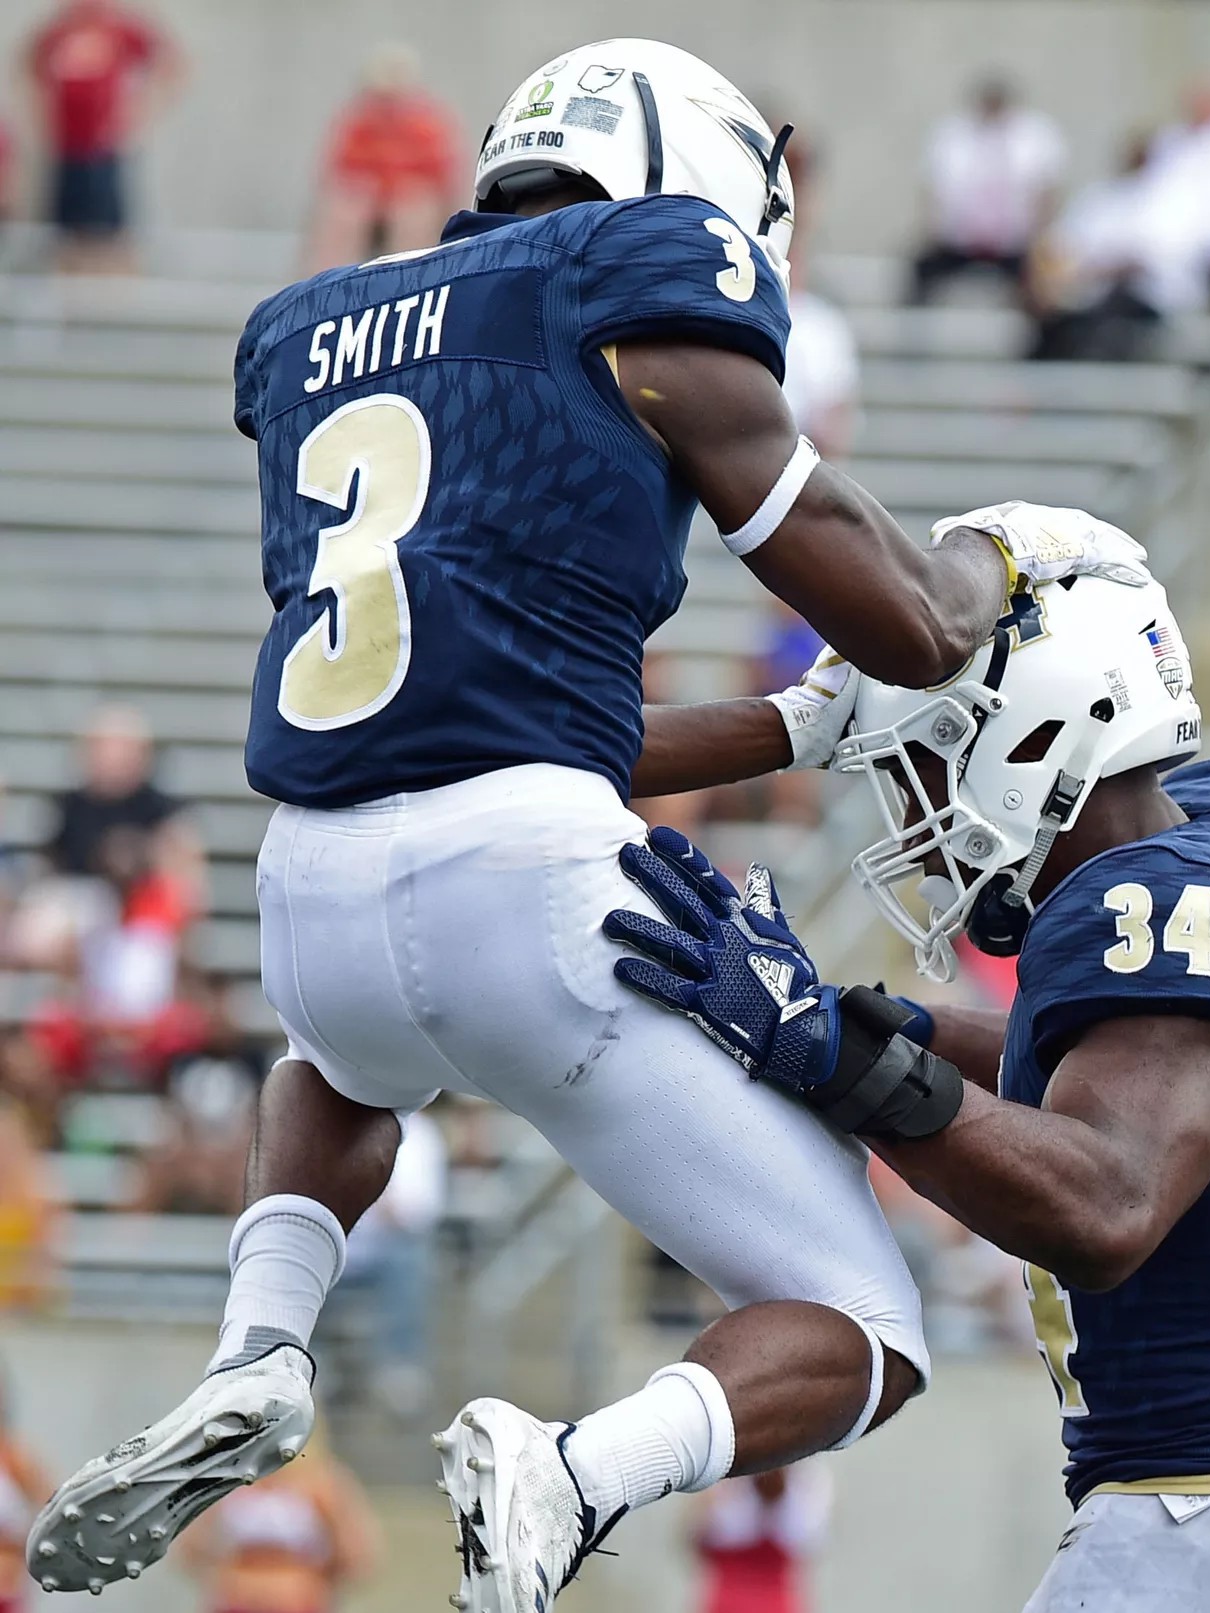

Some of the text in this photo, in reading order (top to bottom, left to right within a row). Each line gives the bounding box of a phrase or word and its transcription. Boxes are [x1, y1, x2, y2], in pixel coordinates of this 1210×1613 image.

[510, 132, 536, 150] THE
[537, 131, 564, 148] ROO
[703, 217, 756, 302] 3
[303, 285, 451, 393] SMITH
[278, 393, 432, 732] 3
[748, 954, 791, 1009] adidas
